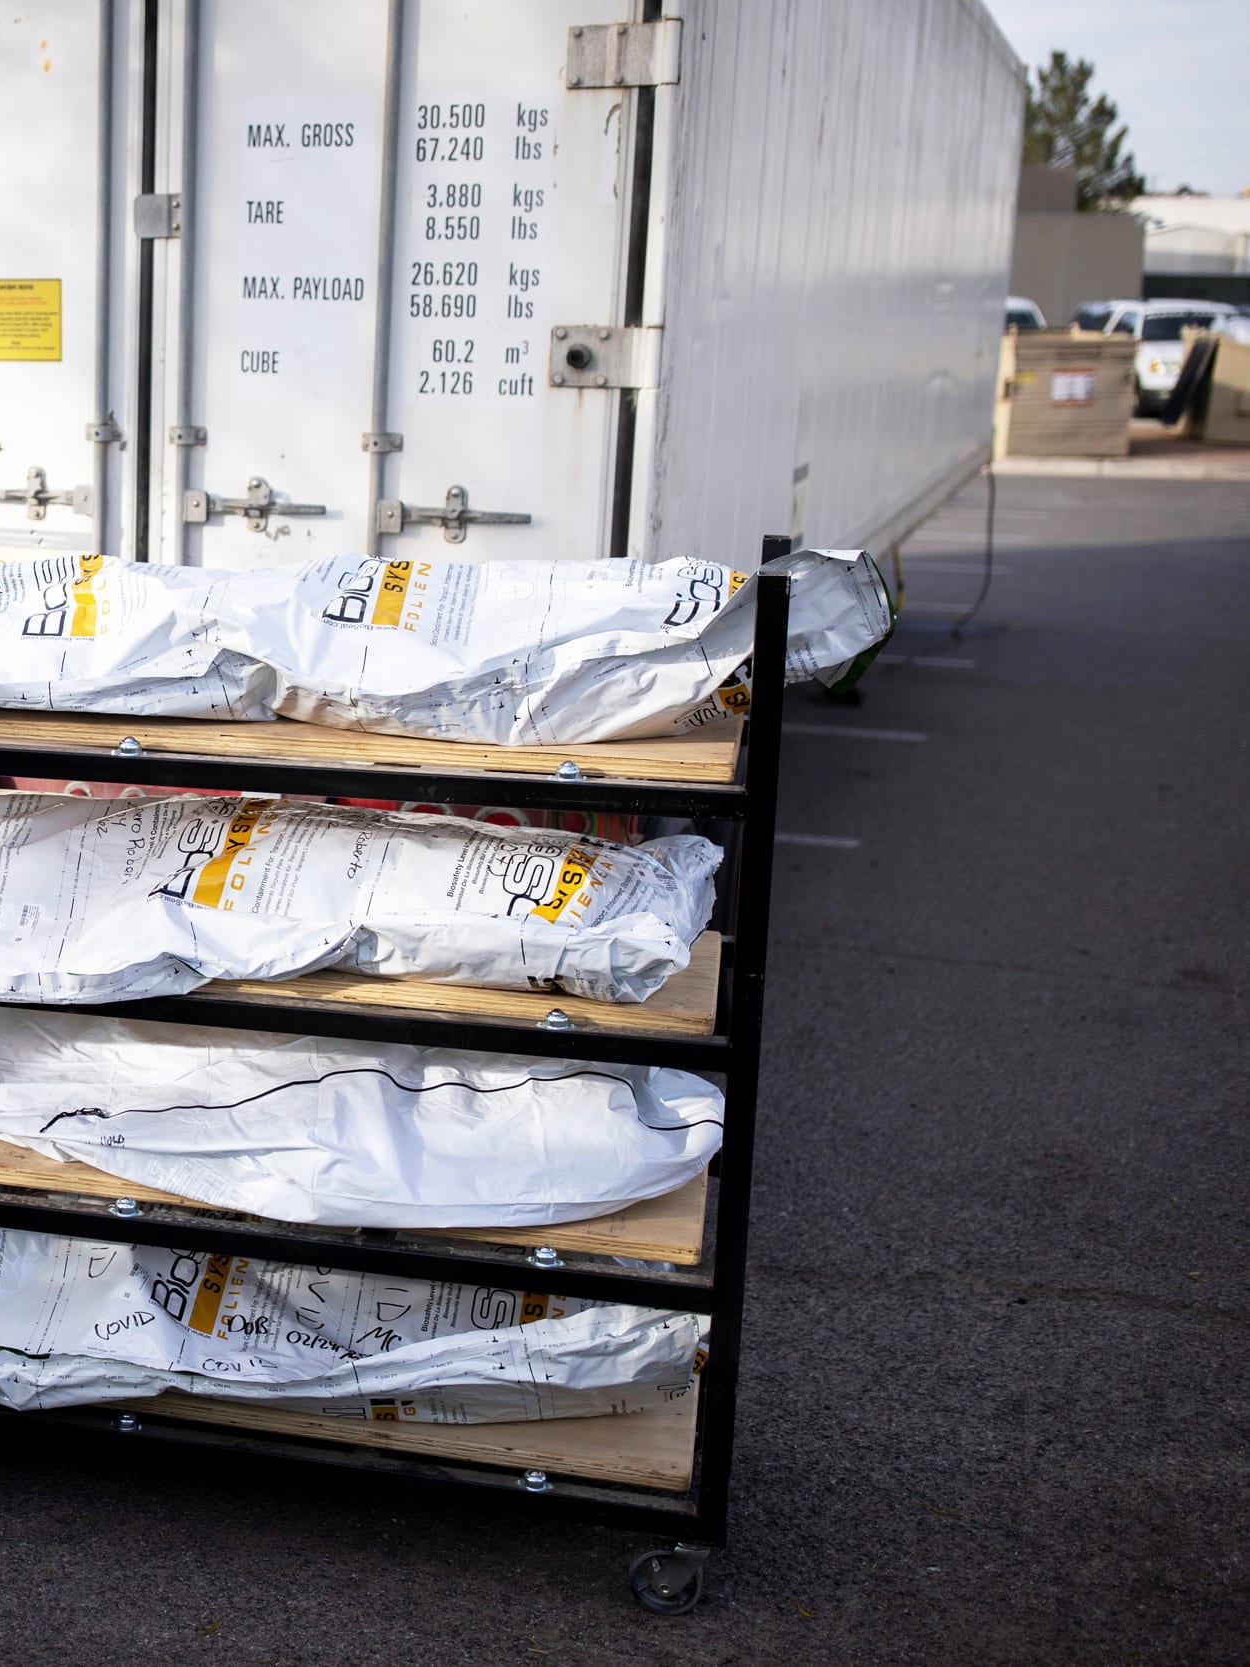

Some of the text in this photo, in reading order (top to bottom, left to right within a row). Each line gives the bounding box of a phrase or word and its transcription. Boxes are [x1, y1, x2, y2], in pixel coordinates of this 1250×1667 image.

[418, 104, 548, 128] 30.500 kgs
[247, 123, 354, 148] MAX. GROSS
[416, 134, 542, 162] 67.240 lbs
[427, 183, 545, 212] 3.880 kgs
[246, 201, 284, 224] TARE
[425, 216, 538, 240] 8.550 lbs
[243, 277, 364, 301] MAX. PAYLOAD
[412, 262, 540, 291] 26.620 kgs
[410, 294, 534, 319] 58.690 lbs
[241, 350, 279, 374] CUBE
[432, 339, 475, 364] 60.2
[419, 370, 534, 396] 2.126 cuft
[402, 561, 432, 632] FOLIEN
[346, 831, 372, 878] Roberto
[251, 867, 271, 913] Containment
[446, 863, 463, 897] Biosafety
[421, 1283, 436, 1332] Biosafety Level
[433, 1313, 439, 1321] De
[94, 1312, 155, 1340] COVID
[227, 1314, 269, 1336] DOB
